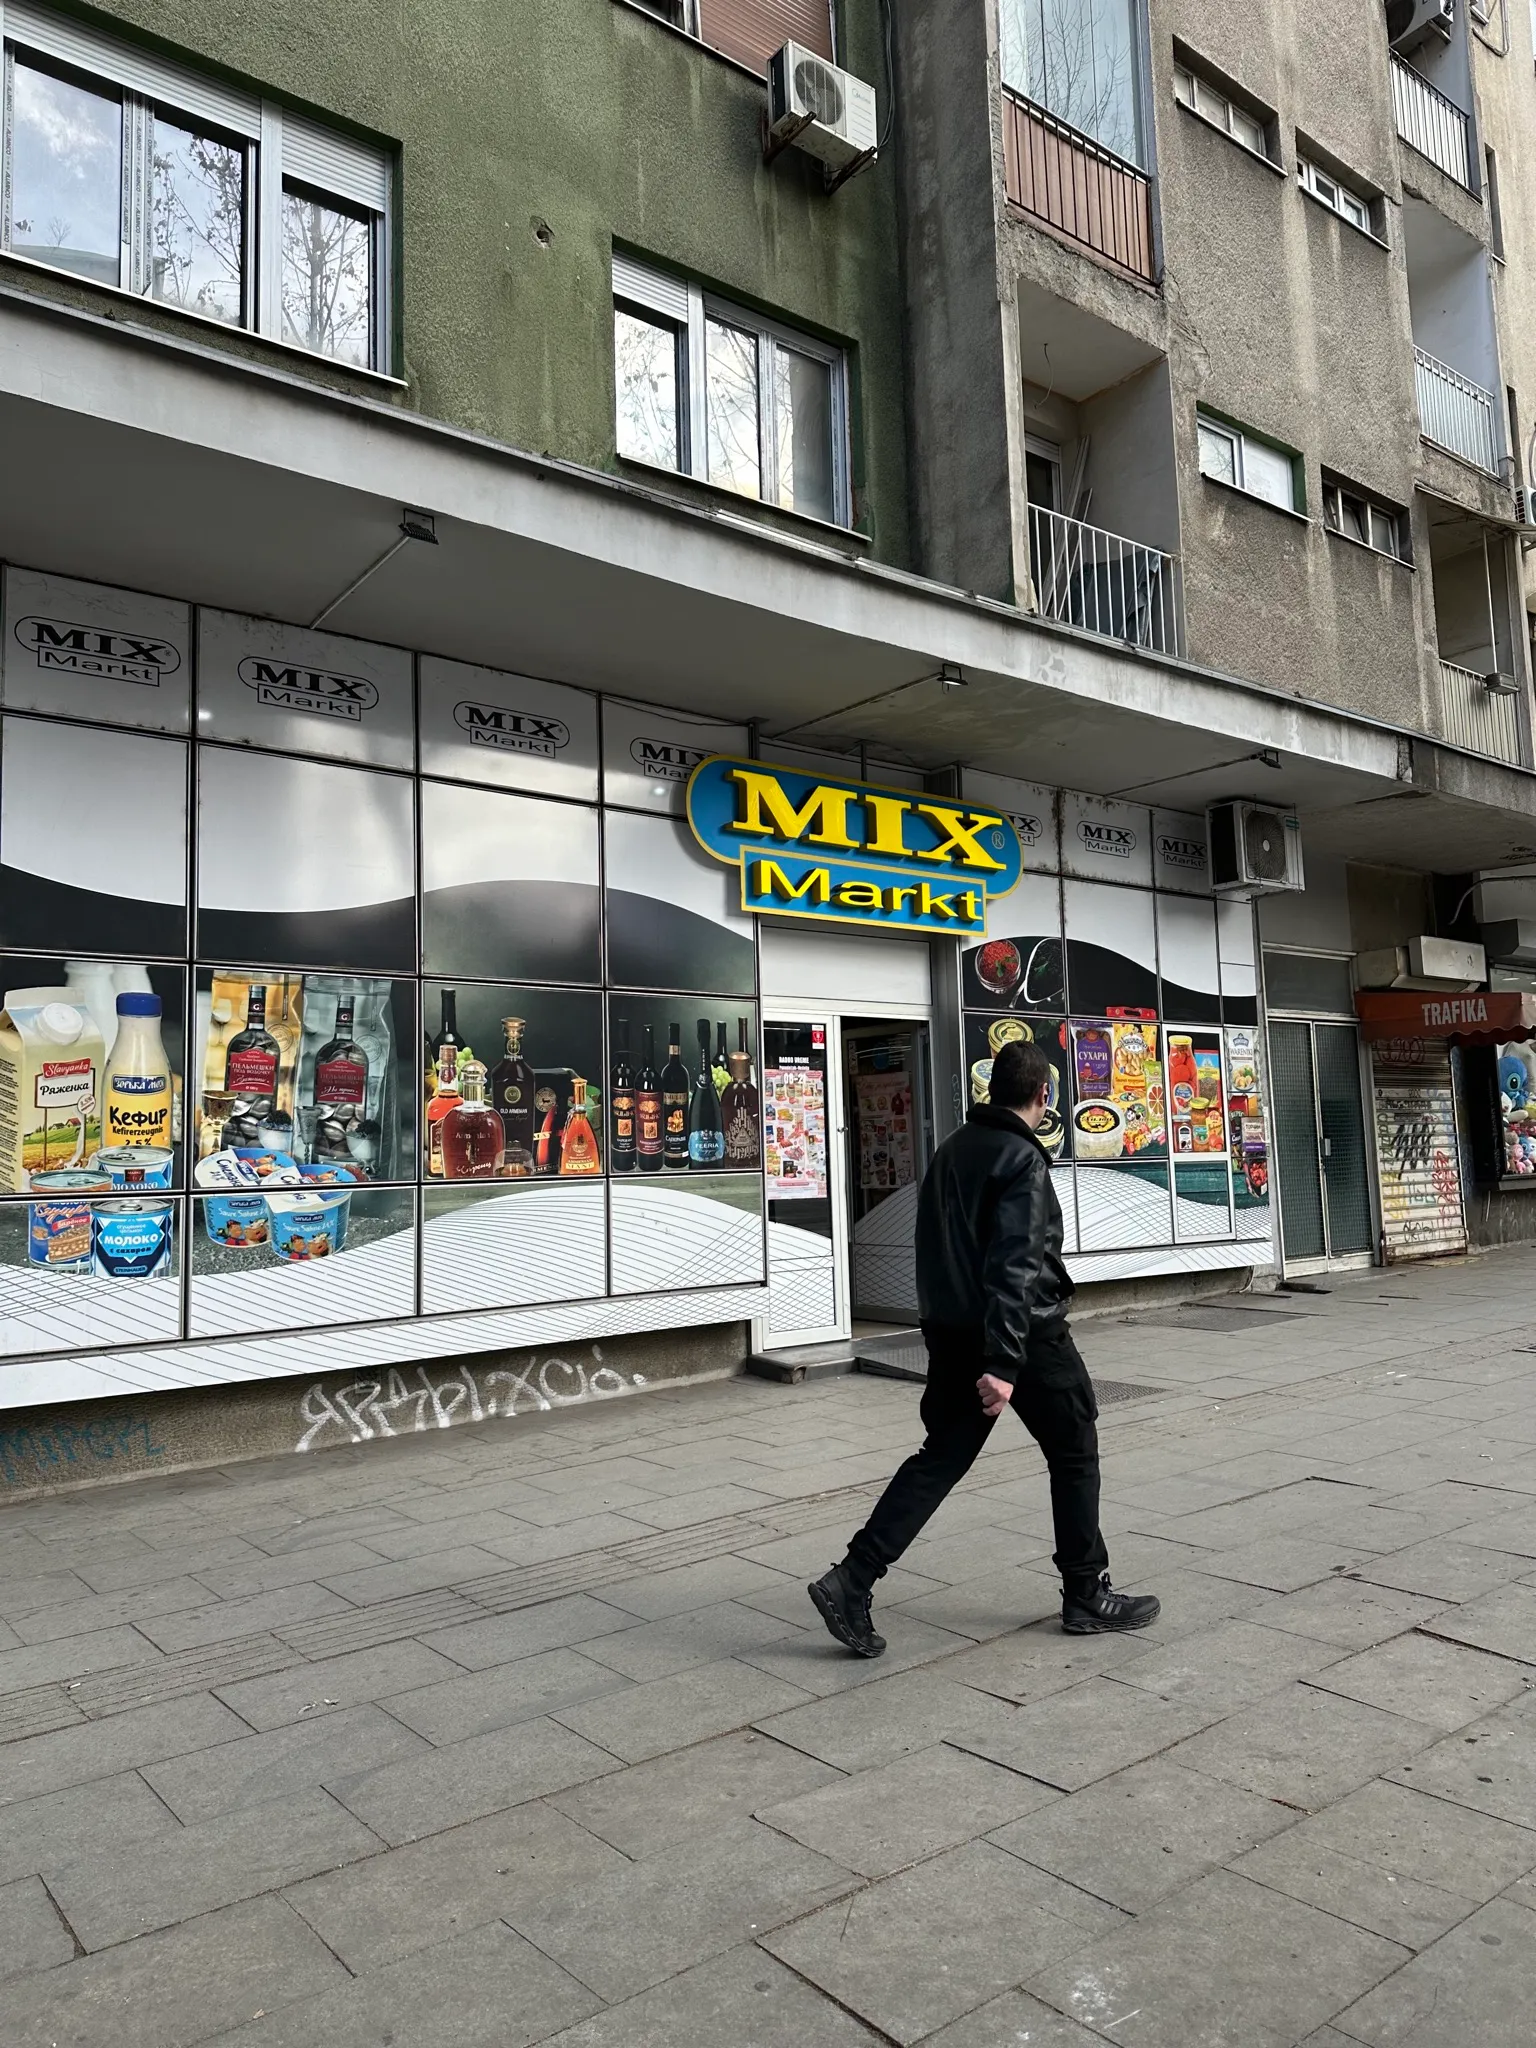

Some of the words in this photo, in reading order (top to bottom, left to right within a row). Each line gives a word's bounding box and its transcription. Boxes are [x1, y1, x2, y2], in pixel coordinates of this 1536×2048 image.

[30, 622, 166, 665] MIX
[44, 652, 153, 680] Markt
[252, 662, 367, 701] MIX
[264, 688, 356, 715] Markt
[464, 706, 560, 740] MIX
[474, 730, 551, 753] Markt
[647, 764, 690, 779] Mar
[727, 769, 1006, 870] MIX
[1008, 815, 1038, 832] IX
[1083, 824, 1131, 844] MIX
[1087, 841, 1127, 855] Markt
[1161, 838, 1206, 858] MIX
[1166, 855, 1202, 867] Markt
[754, 859, 983, 921] Markt
[1422, 998, 1488, 1026] TRAFIKA
[1078, 1051, 1108, 1061] СУХАРИ
[45, 1061, 89, 1077] Slavyanka
[232, 1062, 275, 1071] ПЕЛЬМЕШКИ
[40, 1083, 89, 1096] Ряженка
[109, 1105, 168, 1127] Кефир
[112, 1125, 164, 1136] Kefirerzeugnis
